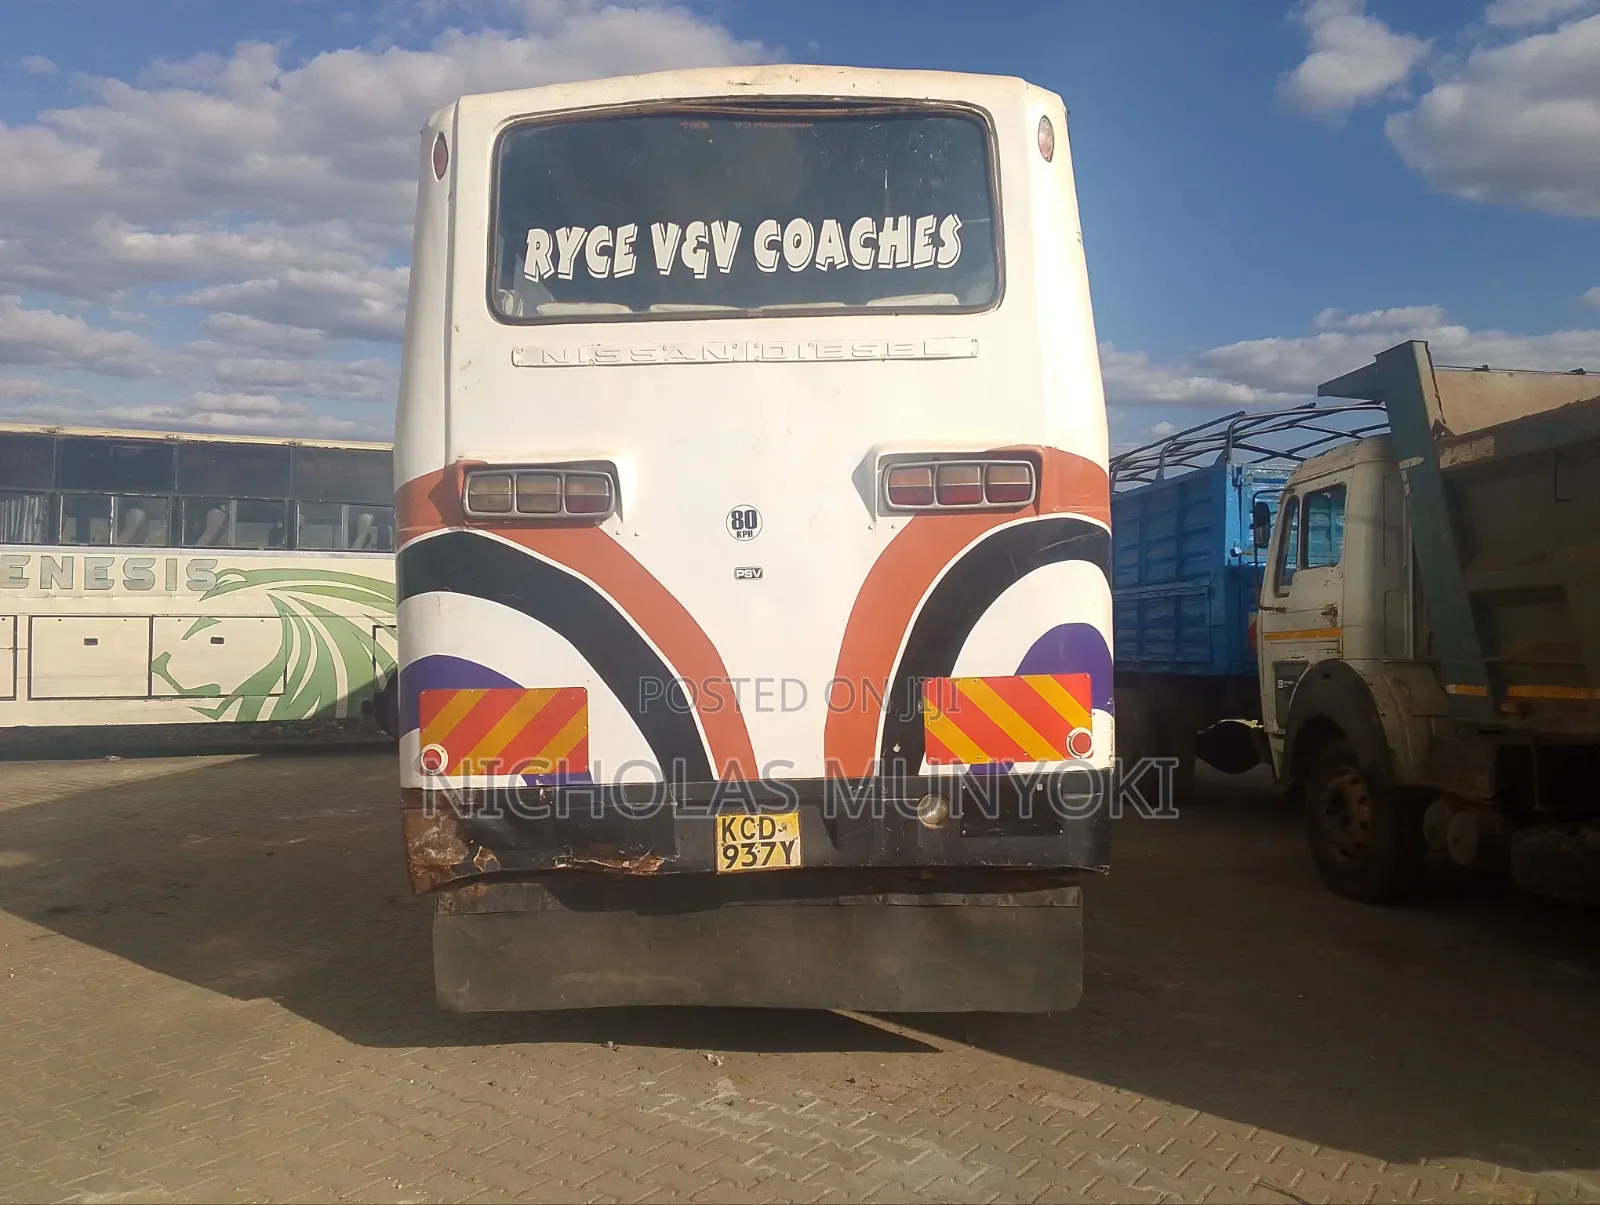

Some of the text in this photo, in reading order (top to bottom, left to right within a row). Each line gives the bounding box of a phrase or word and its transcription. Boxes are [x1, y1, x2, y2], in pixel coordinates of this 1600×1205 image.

[524, 213, 962, 283] RYCE V&V COACHES
[540, 339, 951, 364] NISSAN DIESEL
[731, 509, 758, 530] 80
[736, 530, 754, 539] KPH
[735, 568, 762, 580] PSV
[721, 816, 776, 842] KCD
[722, 840, 795, 869] 937Y
